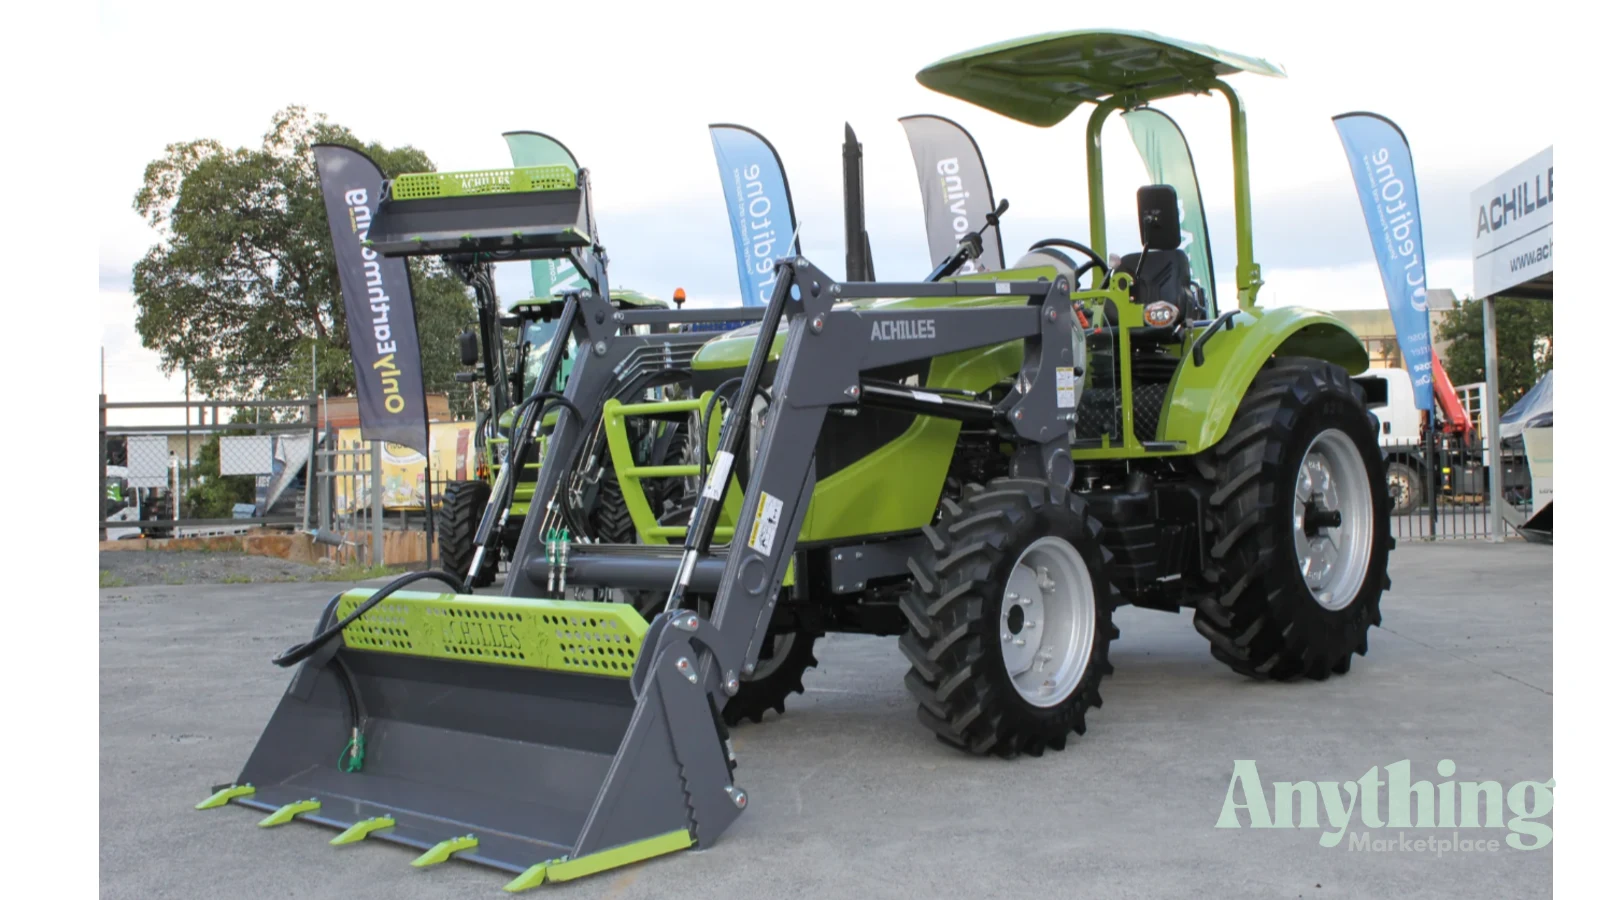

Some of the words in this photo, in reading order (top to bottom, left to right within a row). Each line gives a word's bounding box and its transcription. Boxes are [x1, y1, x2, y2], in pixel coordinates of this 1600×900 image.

[461, 175, 511, 189] ACHILLES
[870, 319, 936, 341] ACHILLES
[441, 619, 523, 650] ACHILLES
